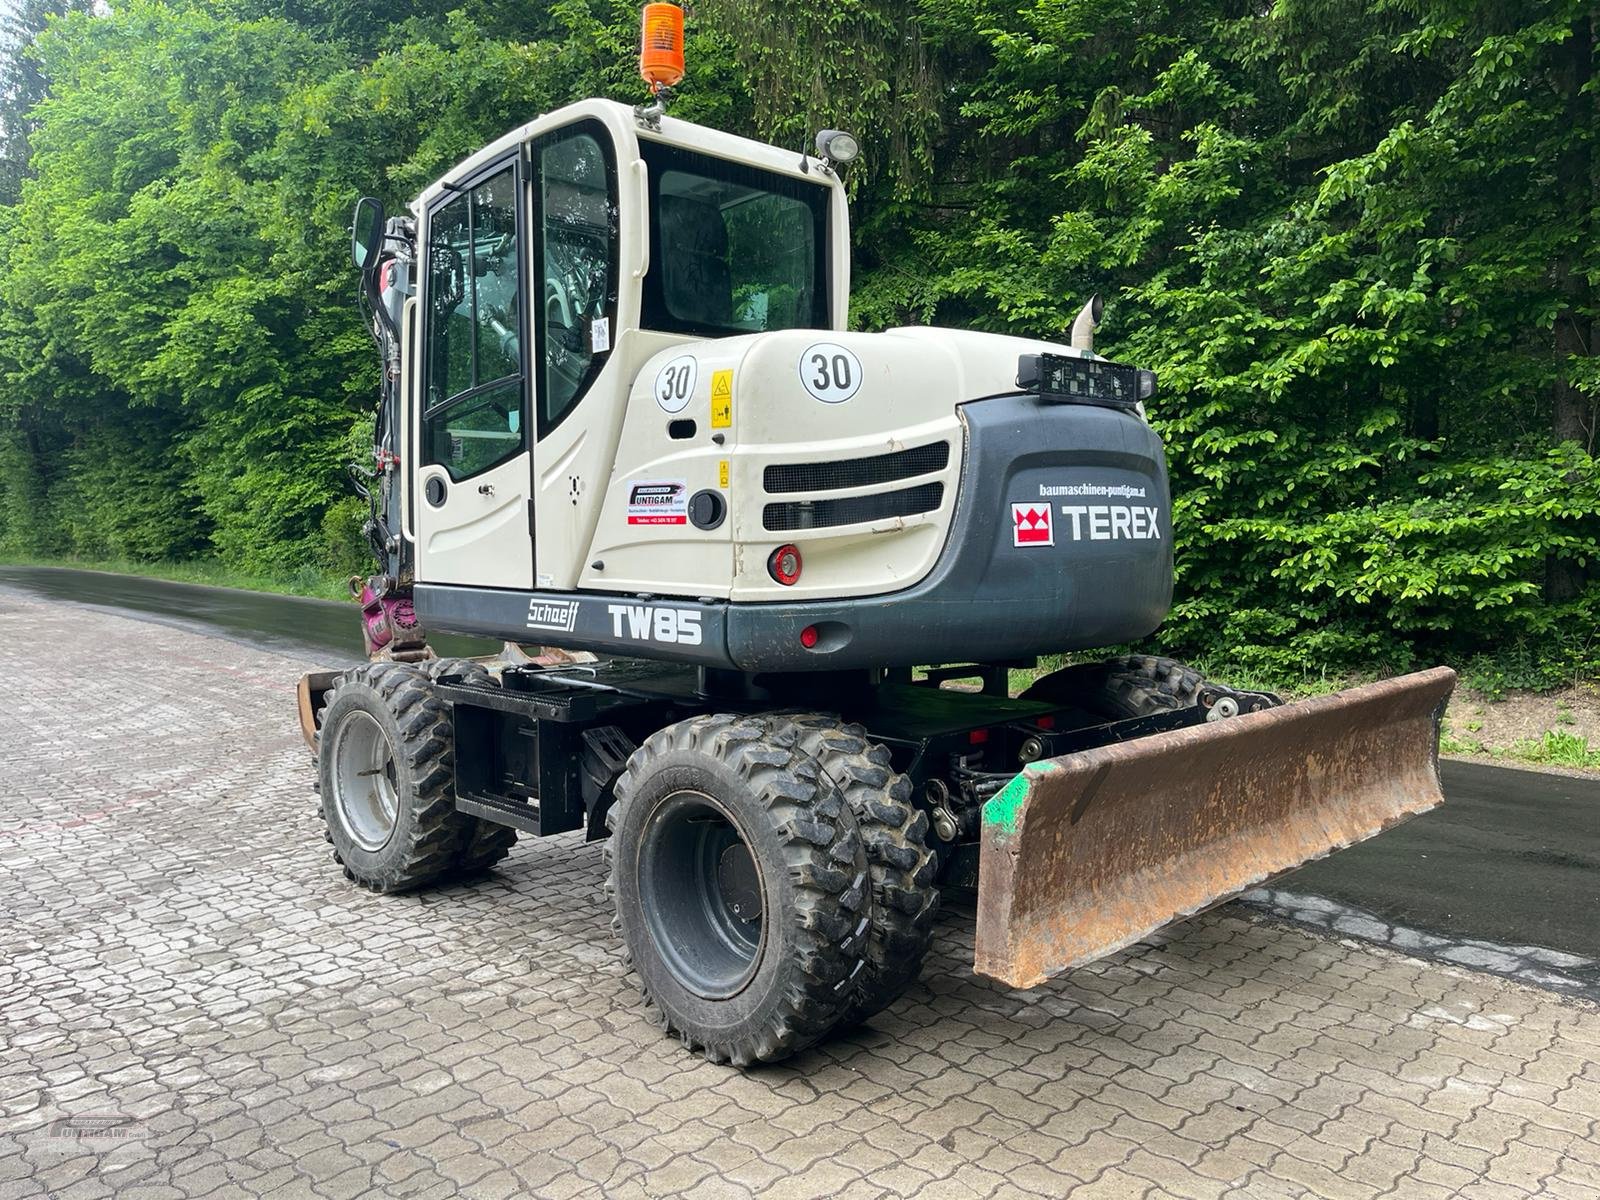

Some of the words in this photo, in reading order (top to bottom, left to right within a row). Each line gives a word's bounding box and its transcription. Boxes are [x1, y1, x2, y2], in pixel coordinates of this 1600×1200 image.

[662, 365, 690, 400] 30
[811, 354, 851, 390] 30
[1040, 484, 1146, 498] baumaschinen-puntigam.at
[1062, 506, 1160, 540] TEREX
[527, 599, 579, 632] Schaeff
[608, 604, 702, 646] TW85
